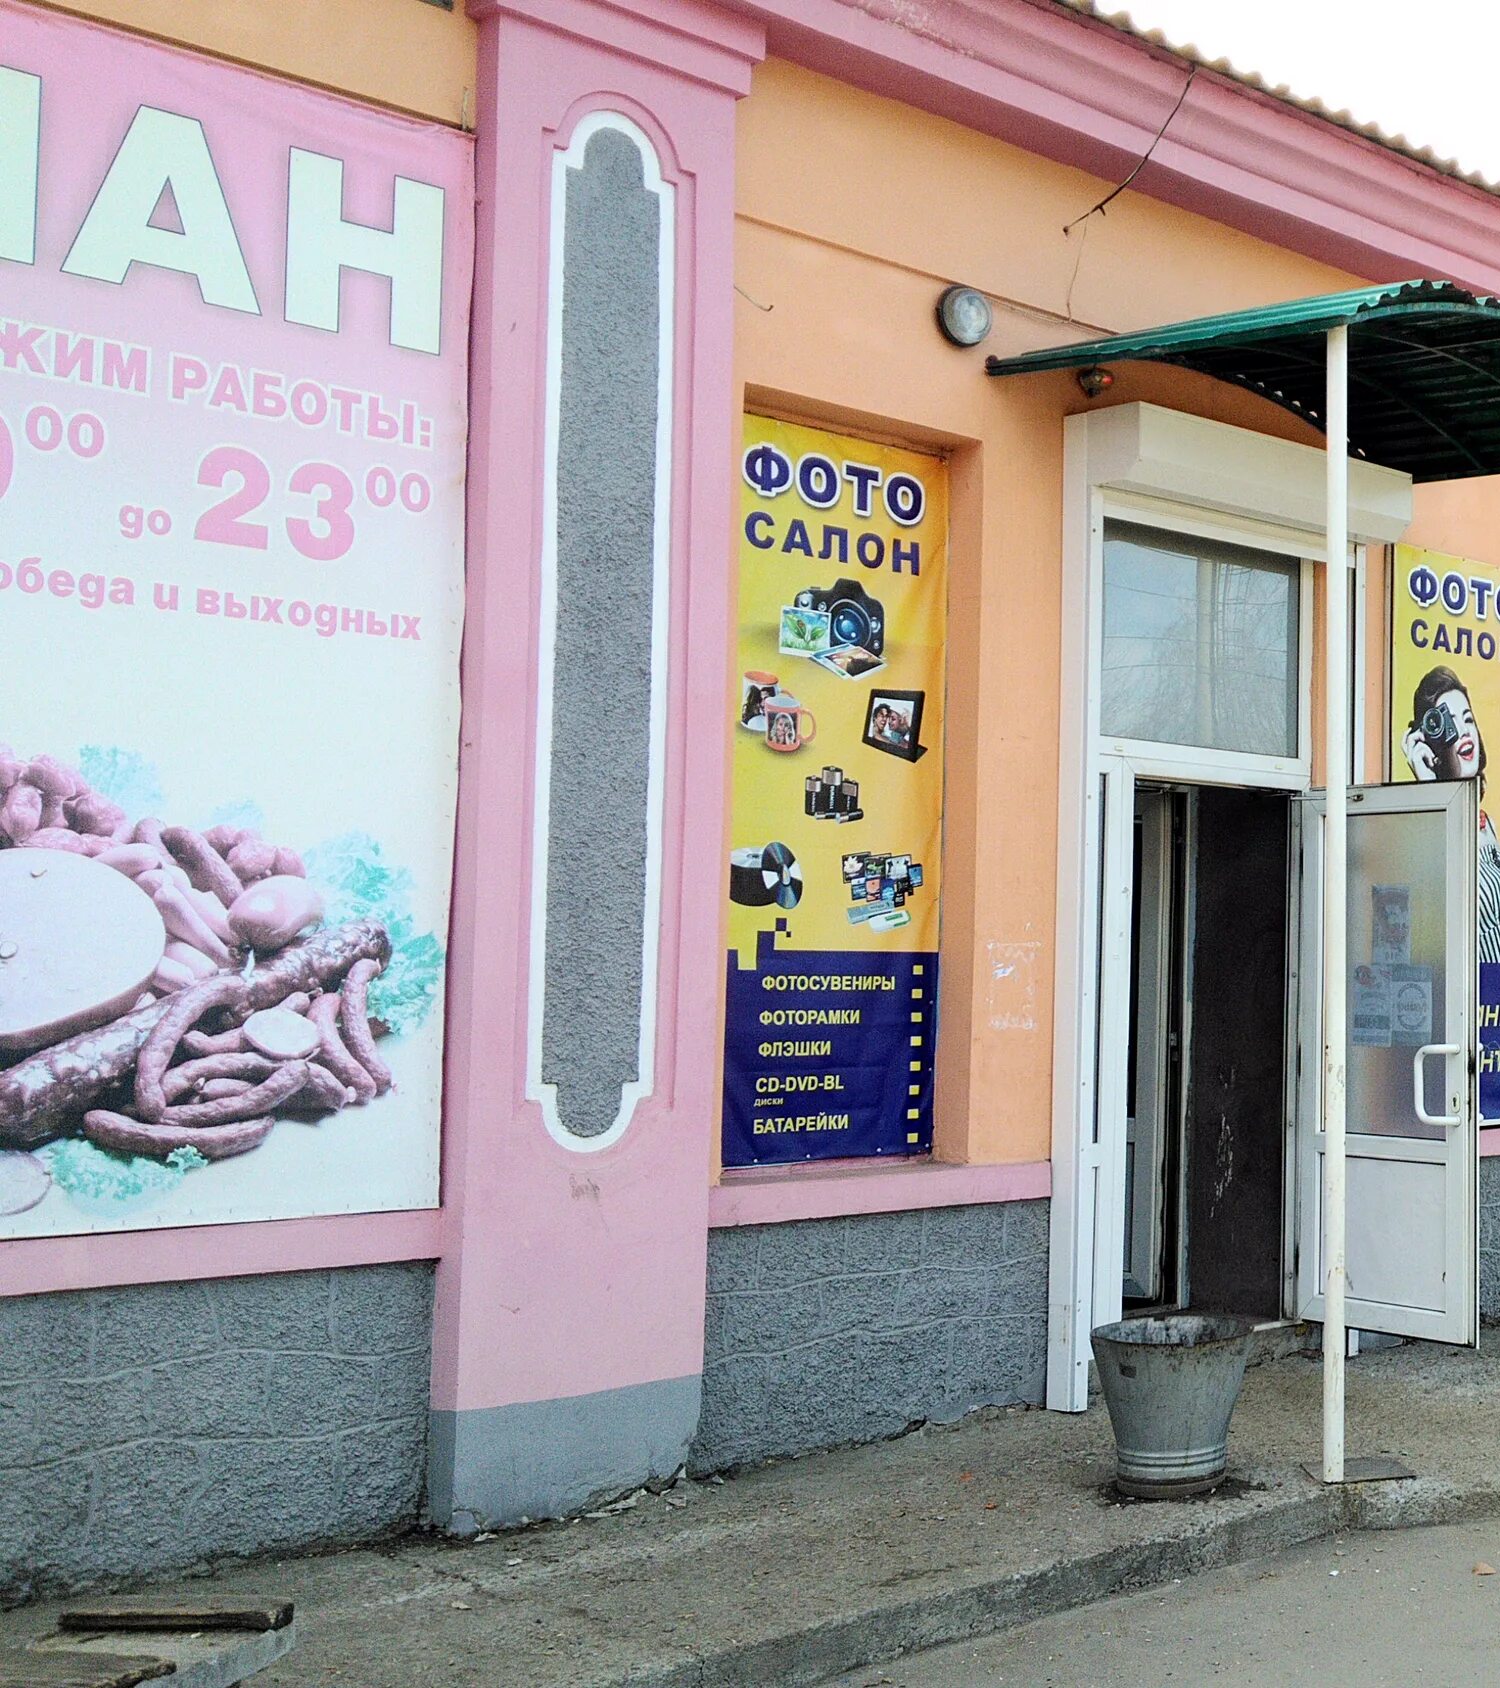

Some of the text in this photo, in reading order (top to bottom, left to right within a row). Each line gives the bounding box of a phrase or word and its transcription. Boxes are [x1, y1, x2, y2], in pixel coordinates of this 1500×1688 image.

[170, 354, 433, 449] РАБОТЫ:
[743, 443, 925, 523] ФОТО
[118, 504, 172, 540] до
[744, 510, 921, 577] САЛОН
[152, 582, 180, 611] и
[195, 587, 422, 641] выходных
[761, 975, 896, 991] ФОТОСУВЕНИРЫ
[758, 1009, 861, 1026] ФОТОРАМКИ
[758, 1040, 832, 1057] ФЛЭШКИ
[755, 1075, 844, 1093] CD-DVD-BL
[753, 1111, 849, 1134] БАТАРЕЙКИ
